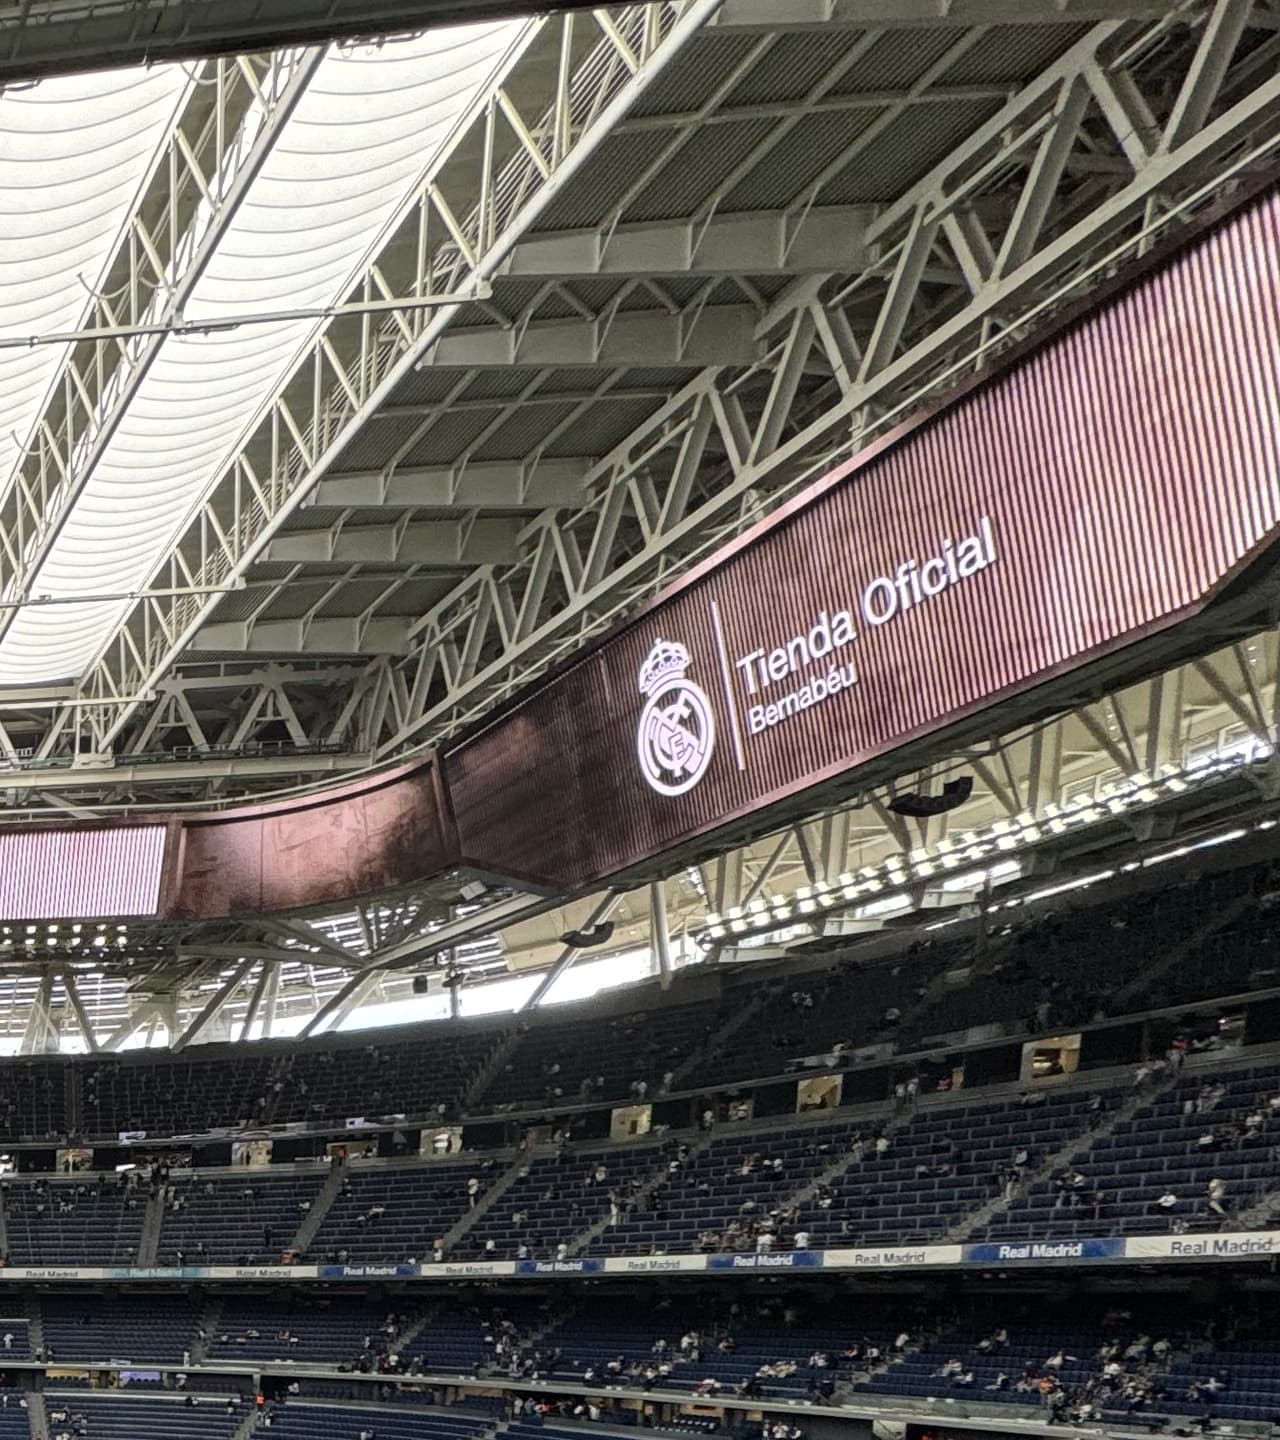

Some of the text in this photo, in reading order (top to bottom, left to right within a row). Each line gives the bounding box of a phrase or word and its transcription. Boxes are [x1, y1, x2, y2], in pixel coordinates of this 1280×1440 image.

[737, 515, 996, 695] Tienda Oficial
[748, 663, 857, 734] Bernabéu
[999, 1243, 1082, 1258] Real Madrid
[1171, 1237, 1274, 1255] Real Madrid
[733, 1254, 793, 1266] Real Madrid
[855, 1252, 926, 1265] Real Madrid
[343, 1267, 397, 1276] Real Madrid
